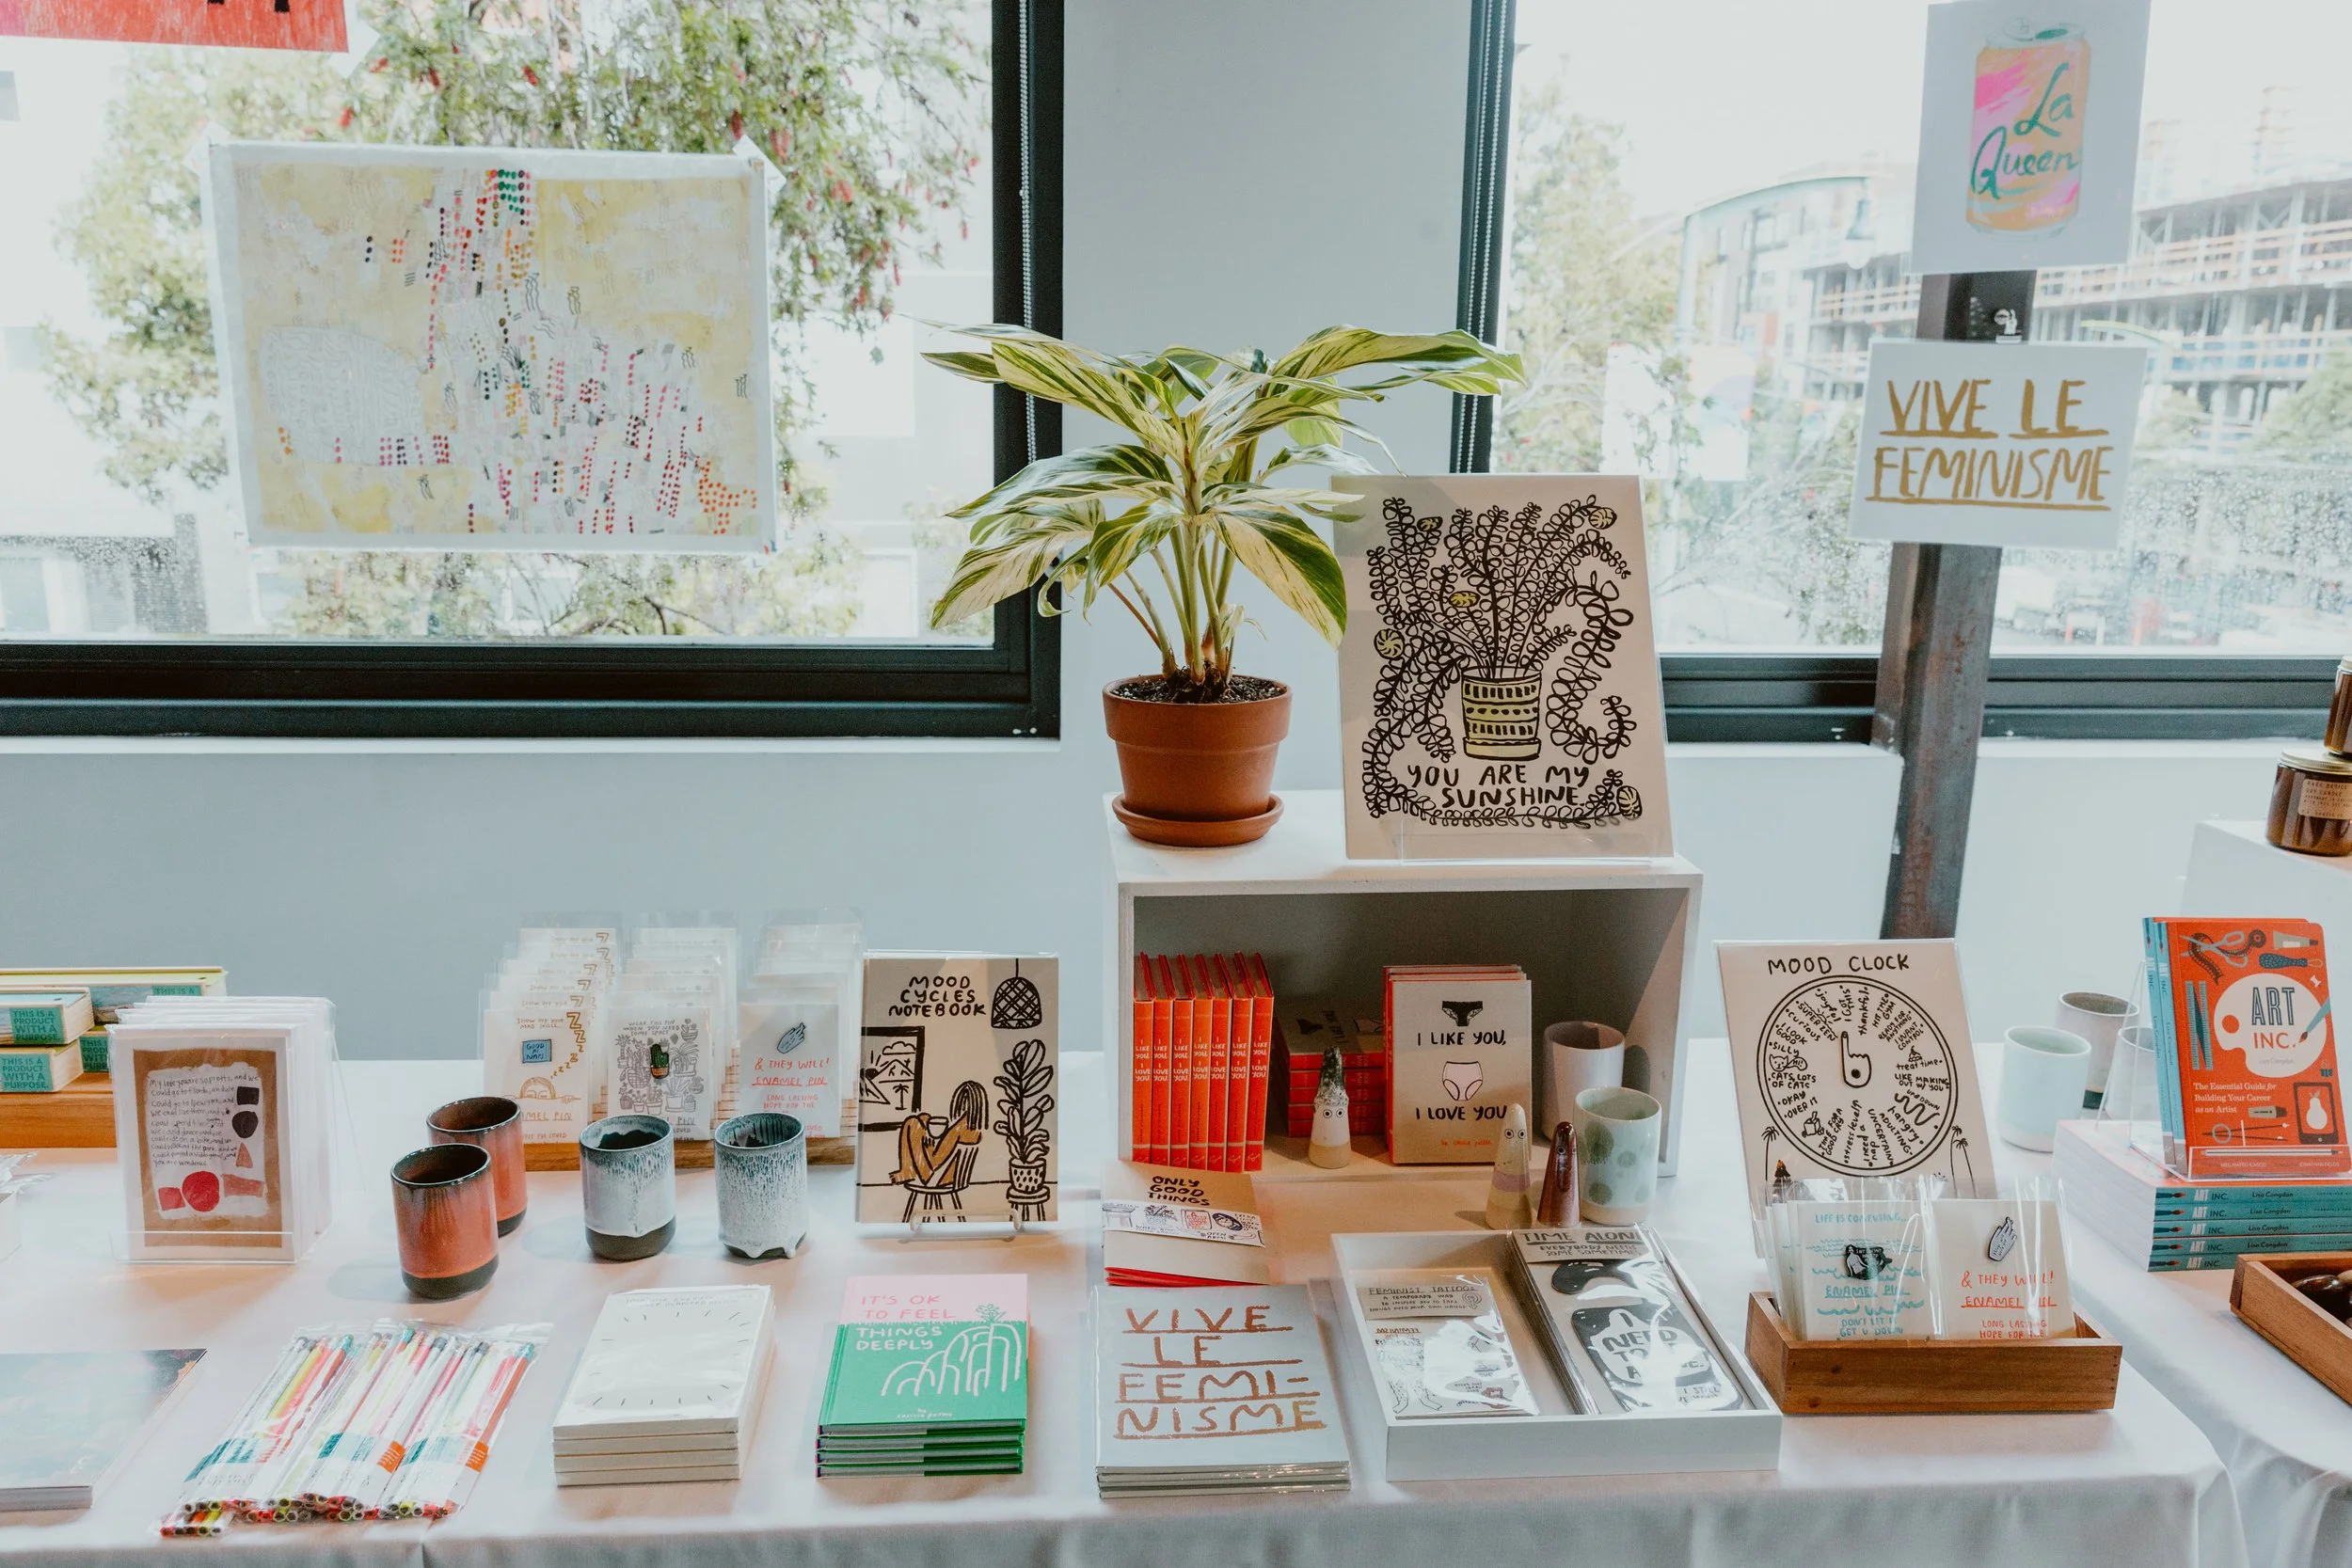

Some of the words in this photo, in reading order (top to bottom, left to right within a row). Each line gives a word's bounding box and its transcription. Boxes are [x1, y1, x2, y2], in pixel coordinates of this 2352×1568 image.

[2014, 63, 2074, 137] La
[1971, 127, 2081, 199] Queen
[1887, 378, 1993, 433] VIVE
[2019, 378, 2090, 434] LE
[1872, 446, 2114, 502] FEMINISME
[1407, 765, 1459, 787] YOU
[1479, 765, 1527, 786] ARE
[1546, 765, 1590, 787] MY
[1768, 957, 1832, 974] MOOD
[1849, 954, 1910, 972] CLOCK
[909, 975, 971, 989] MOOD
[900, 990, 976, 1003] CYCLES
[1842, 989, 1854, 1009] THIS
[889, 1004, 986, 1017] NOTEBOOK
[1815, 990, 1841, 1022] joyful
[1838, 999, 1851, 1016] GOT
[1858, 990, 1869, 1036] thankful
[1872, 1013, 1882, 1028] HIT
[1877, 997, 1889, 1012] THE
[1883, 1002, 1896, 1020] GYM
[2251, 987, 2296, 1026] ART
[15, 1024, 45, 1033] WITH
[47, 1024, 57, 1033] A
[1788, 1011, 1821, 1042] curious
[1798, 1003, 1821, 1026] SUPER
[1820, 1024, 1836, 1041] ZEN
[1878, 1022, 1896, 1040] READY
[1894, 1010, 1906, 1022] FOR
[1885, 1014, 1913, 1043] ANYTHING
[1417, 1033, 1422, 1046] I
[1431, 1032, 1465, 1045] LIKE
[1472, 1029, 1506, 1046] YOU,
[1775, 1028, 1797, 1045] GOOD
[1786, 1026, 1807, 1045] LOOK
[1898, 1029, 1924, 1051] CONTROL
[1899, 1022, 1918, 1042] WANT
[1772, 1041, 1800, 1057] SILLY
[2253, 1032, 2296, 1050] INC.
[769, 1060, 793, 1069] THEY
[798, 1057, 829, 1069] WILL!
[1896, 1062, 1918, 1070] treat
[3, 1071, 34, 1081] WITH
[35, 1071, 45, 1081] A
[755, 1077, 801, 1085] ENAMEL
[808, 1076, 826, 1085] PIN
[1797, 1074, 1817, 1083] LOTS
[1915, 1077, 1949, 1085] MAKING
[2265, 1083, 2277, 1091] for
[1782, 1090, 1806, 1105] OKAY
[1919, 1097, 1940, 1110] DOWN
[2194, 1094, 2226, 1102] Building
[1416, 1107, 1421, 1119] I
[1427, 1106, 1466, 1120] LOVE
[1473, 1105, 1507, 1121] YOU
[1788, 1101, 1808, 1118] OVER
[1809, 1097, 1818, 1106] IT
[2216, 1105, 2237, 1114] Artist
[1887, 1106, 1920, 1143] hangry
[1867, 1108, 1894, 1161] UNCERTAIN
[1879, 1113, 1912, 1154] ADULTING
[1825, 1133, 1837, 1156] GOOD
[1844, 1132, 1854, 1159] stress
[1856, 1134, 1869, 1157] need
[1869, 1141, 1880, 1161] nap
[1152, 1176, 1200, 1188] ONLY
[1147, 1191, 1211, 1206] THINGS
[1150, 1184, 1205, 1197] GOOD
[2194, 1190, 2209, 1202] ART
[1815, 1214, 1834, 1223] LIFE
[1836, 1214, 1844, 1223] IS
[2193, 1207, 2207, 1218] ART
[1520, 1232, 1572, 1242] TIME
[2191, 1224, 2206, 1235] ART
[1979, 1275, 2008, 1288] THEY
[861, 1295, 898, 1306] IT'S
[909, 1294, 941, 1305] OK
[1964, 1296, 2022, 1307] ENAMEL
[864, 1309, 888, 1320] TO
[899, 1308, 957, 1320] FEEL
[1125, 1305, 1271, 1333] VIVE
[1619, 1312, 1633, 1327] I
[855, 1326, 943, 1338] THINGS
[1839, 1327, 1856, 1337] GET
[1979, 1330, 2002, 1338] HOPE
[2008, 1330, 2024, 1338] FOR
[856, 1339, 933, 1351] DEEPLY
[1153, 1336, 1221, 1366] LE
[1117, 1401, 1327, 1436] NISME
